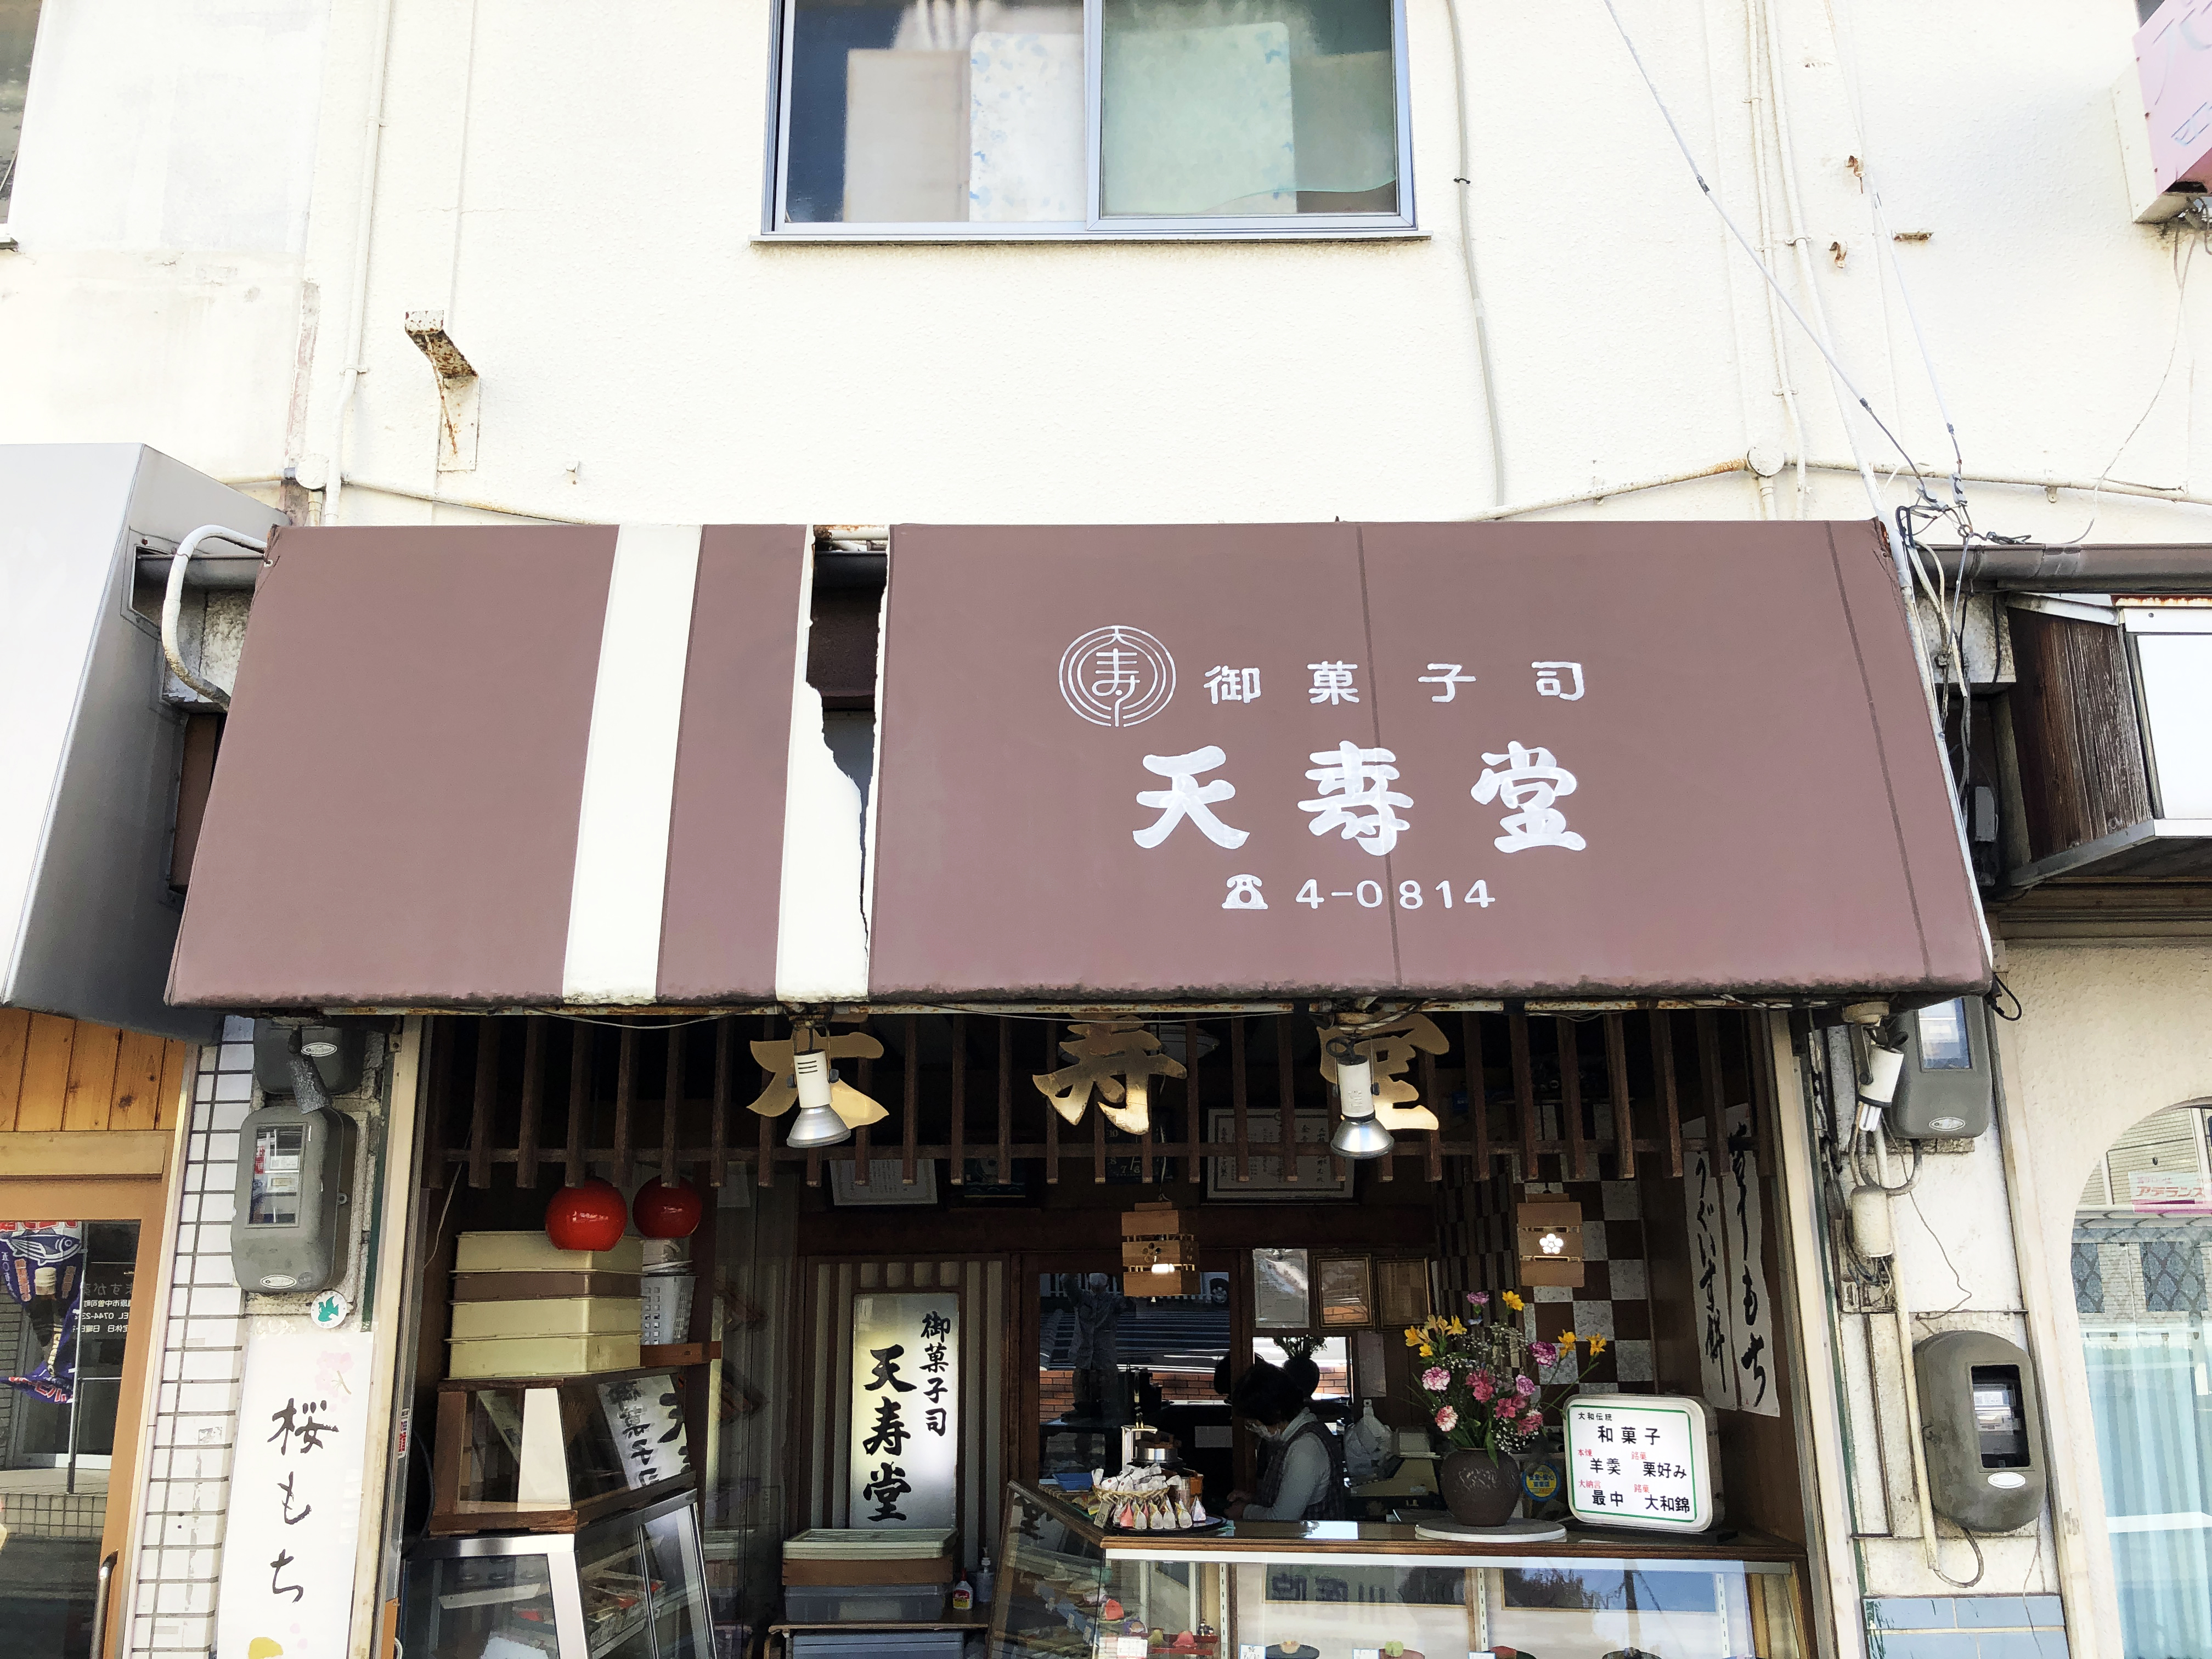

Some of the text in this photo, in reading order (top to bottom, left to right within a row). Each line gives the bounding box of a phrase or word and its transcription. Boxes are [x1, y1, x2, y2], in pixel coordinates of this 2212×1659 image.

[1203, 661, 1584, 704] 御菓子司
[1295, 879, 1496, 909] 4-0814
[920, 1310, 950, 1436] 御菓子司
[1578, 1412, 1613, 1421] 大和伝統
[863, 1344, 917, 1522] 天寿堂
[1597, 1425, 1661, 1446] 和菓子
[1643, 1461, 1687, 1479] 栗好み
[267, 1398, 340, 1603] 桜もち
[1592, 1489, 1624, 1507] 最中
[1644, 1494, 1690, 1514] 大和錦
